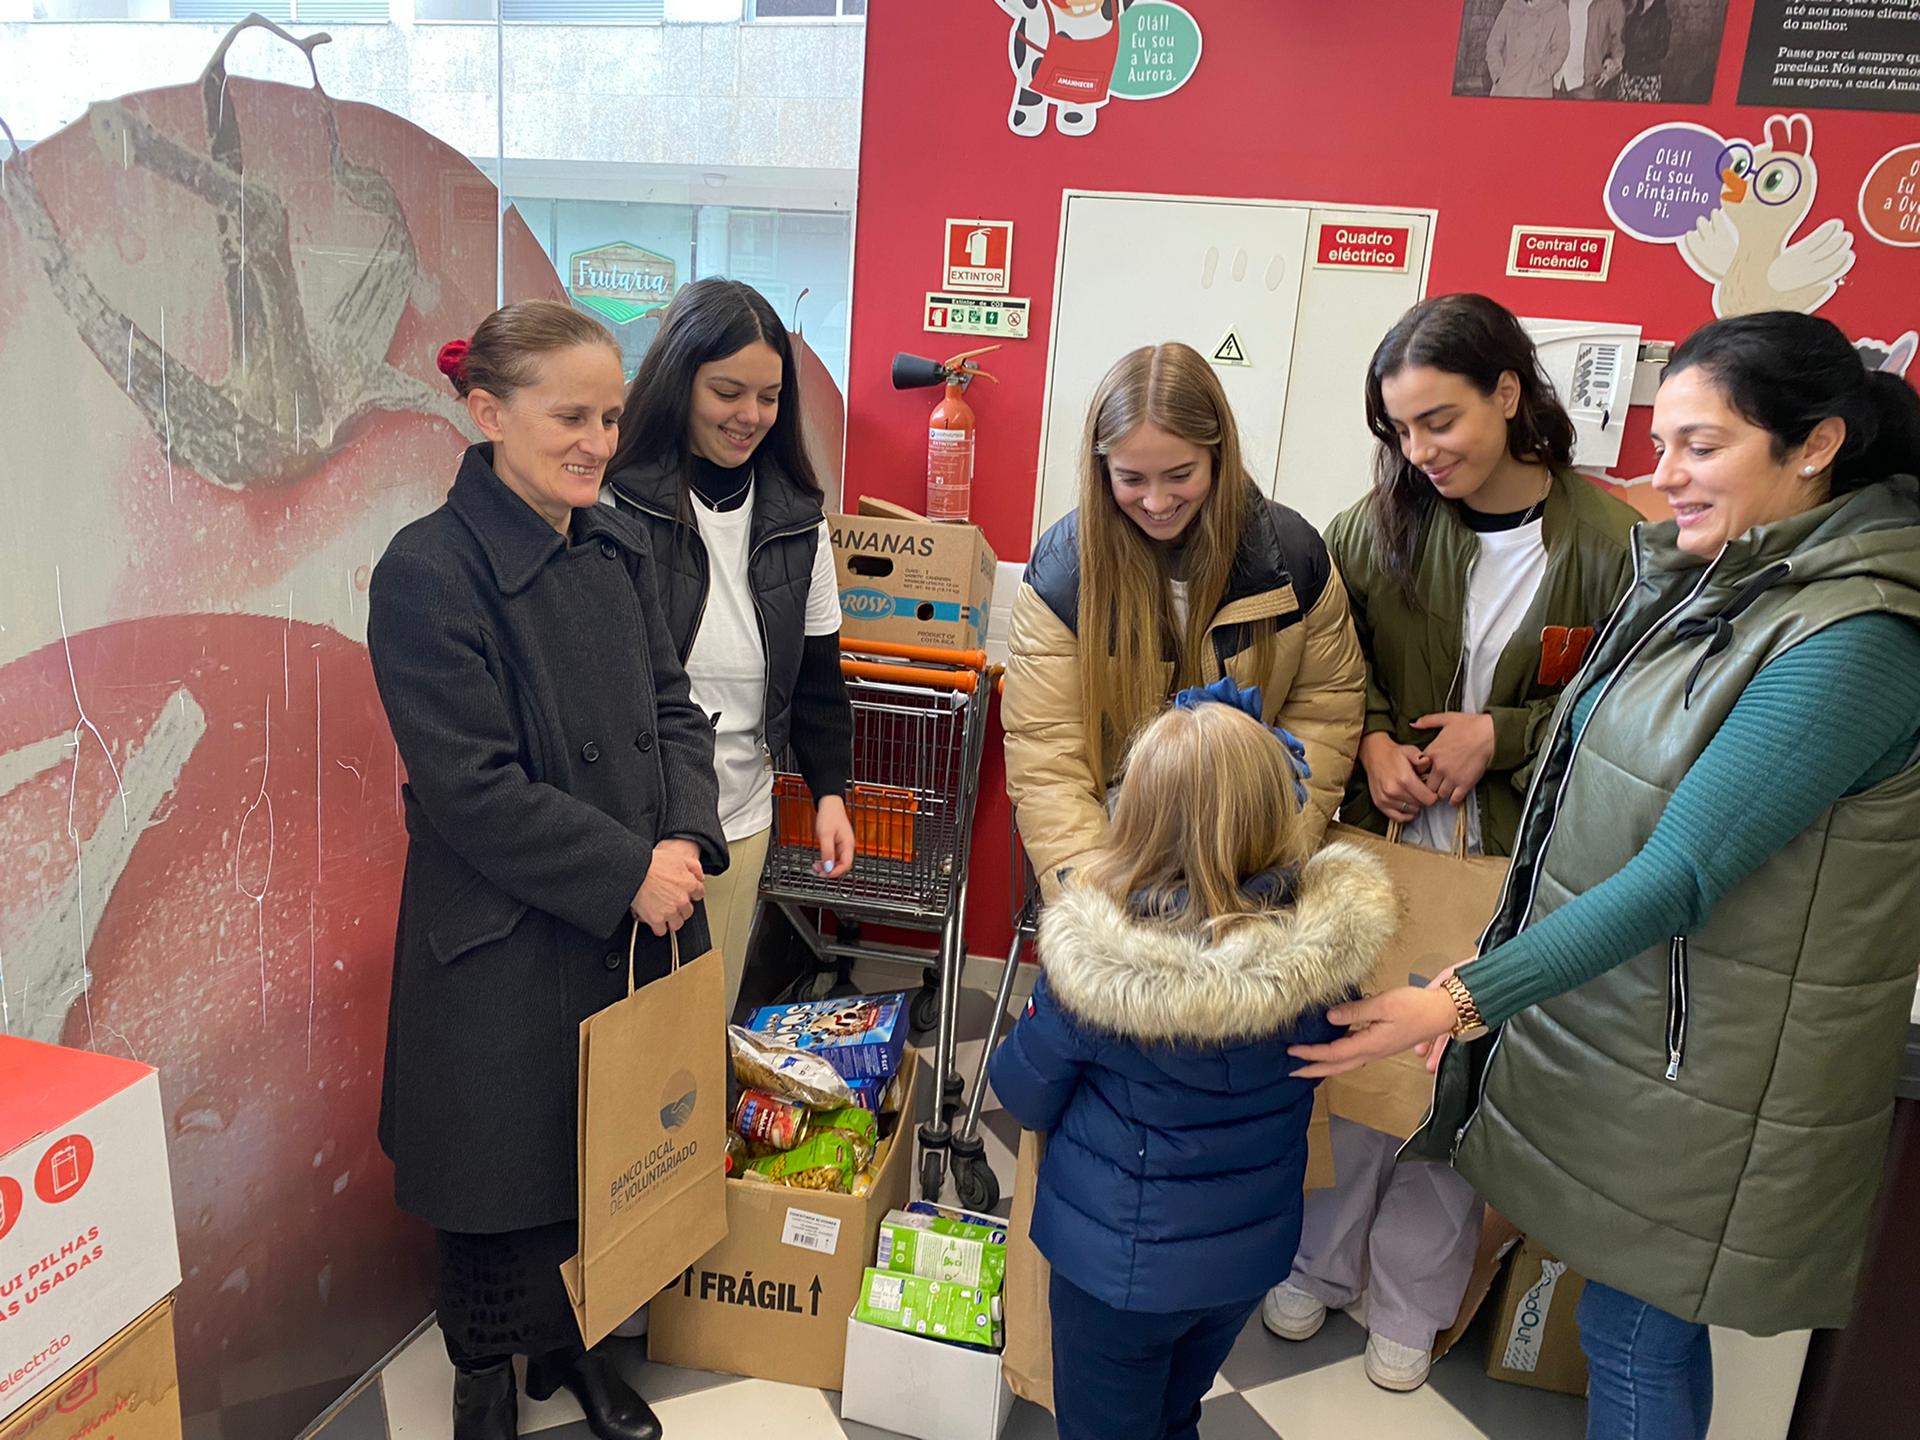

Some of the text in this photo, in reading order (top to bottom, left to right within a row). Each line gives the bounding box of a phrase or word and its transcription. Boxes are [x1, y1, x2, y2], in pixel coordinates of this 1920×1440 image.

[1785, 5, 1920, 20] até aos nossos cliente
[1783, 19, 1848, 31] do melhor.
[1131, 32, 1175, 48] Eu sou
[1130, 49, 1174, 65] a Vaca
[1777, 46, 1814, 59] Passe
[1815, 50, 1840, 61] por
[1841, 49, 1855, 60] cá
[1857, 51, 1904, 63] sempre
[1127, 66, 1177, 83] Aurora.
[1774, 62, 1829, 74] precisar.
[1831, 63, 1856, 74] Nós
[1772, 76, 1794, 87] sua
[1797, 78, 1843, 89] espera,
[1855, 79, 1885, 89] cada
[1645, 165, 1694, 185] Eu sou
[1621, 182, 1709, 204] o Pintainho
[1897, 176, 1916, 194] Eu
[1653, 201, 1670, 219] Pi.
[1883, 197, 1893, 210] a
[1335, 229, 1394, 246] Quadro
[1525, 237, 1598, 253] Central de
[1328, 247, 1396, 264] eléctrico
[1529, 253, 1590, 269] incêndio
[578, 259, 669, 295] Frutaria
[951, 270, 1002, 282] EXTINTOR
[610, 1159, 642, 1197] BANCO
[644, 1138, 675, 1169] LOCAL
[610, 1193, 623, 1217] DE
[624, 1140, 698, 1202] VOLUNTARIADO
[28, 1226, 99, 1280] PILHAS
[25, 1245, 103, 1304] USADAS
[700, 1270, 803, 1314] FRÁGIL
